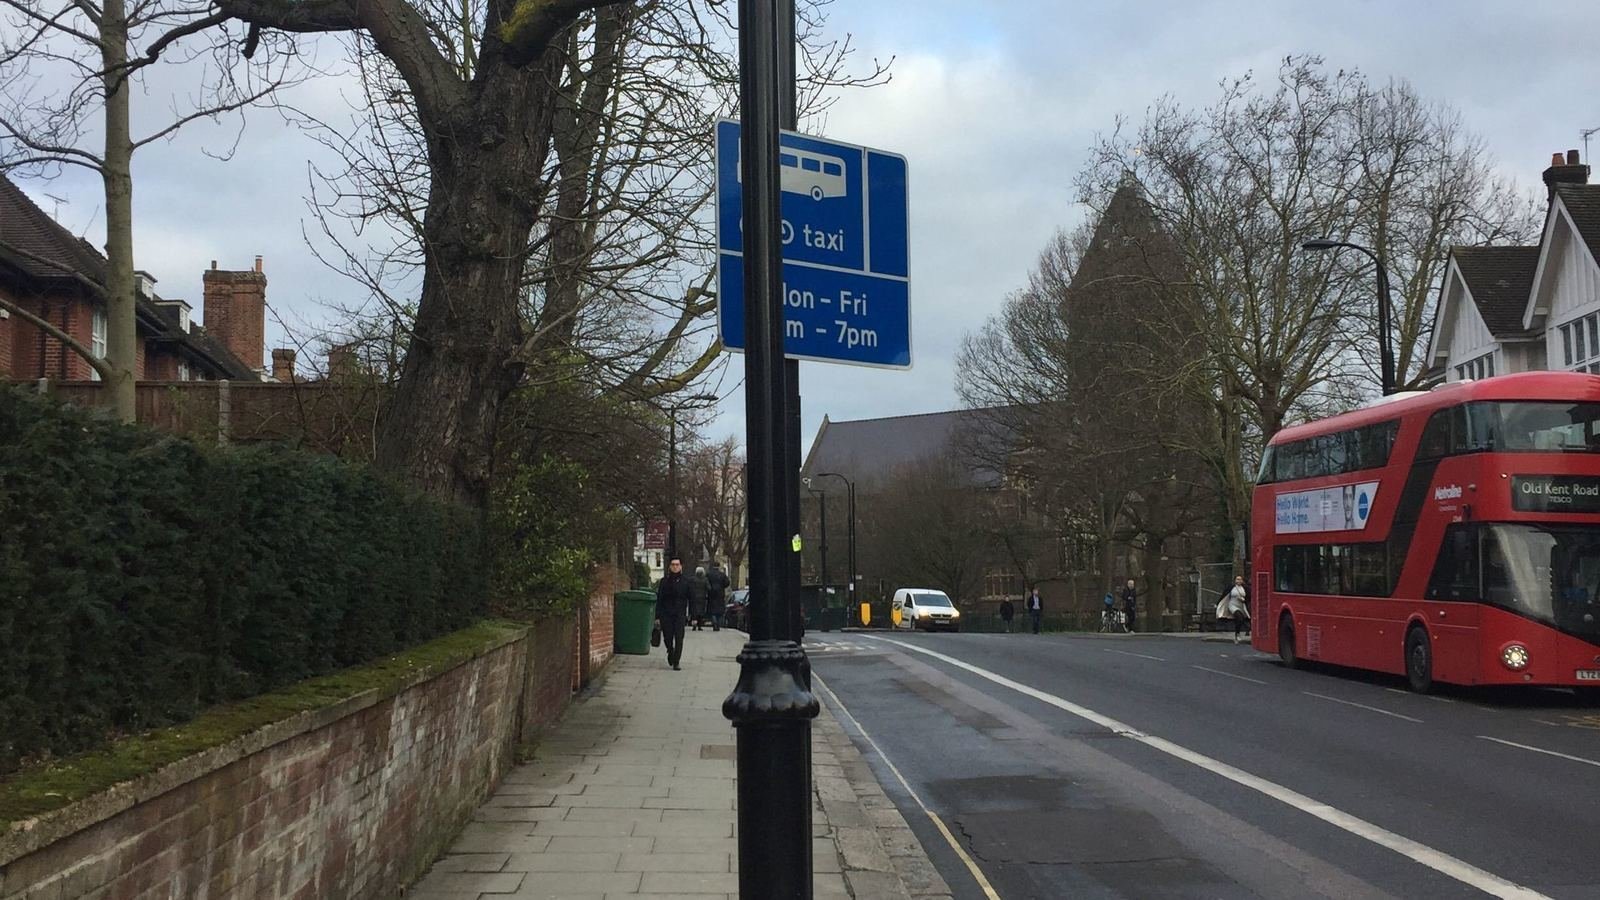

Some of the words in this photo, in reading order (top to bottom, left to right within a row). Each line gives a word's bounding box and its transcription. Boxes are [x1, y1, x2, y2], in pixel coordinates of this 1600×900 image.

[803, 224, 844, 251] taxi
[840, 290, 867, 316] Fri
[835, 320, 877, 348] 7pm
[1522, 481, 1542, 494] Old
[1545, 482, 1569, 495] Kent
[1573, 483, 1599, 496] Road
